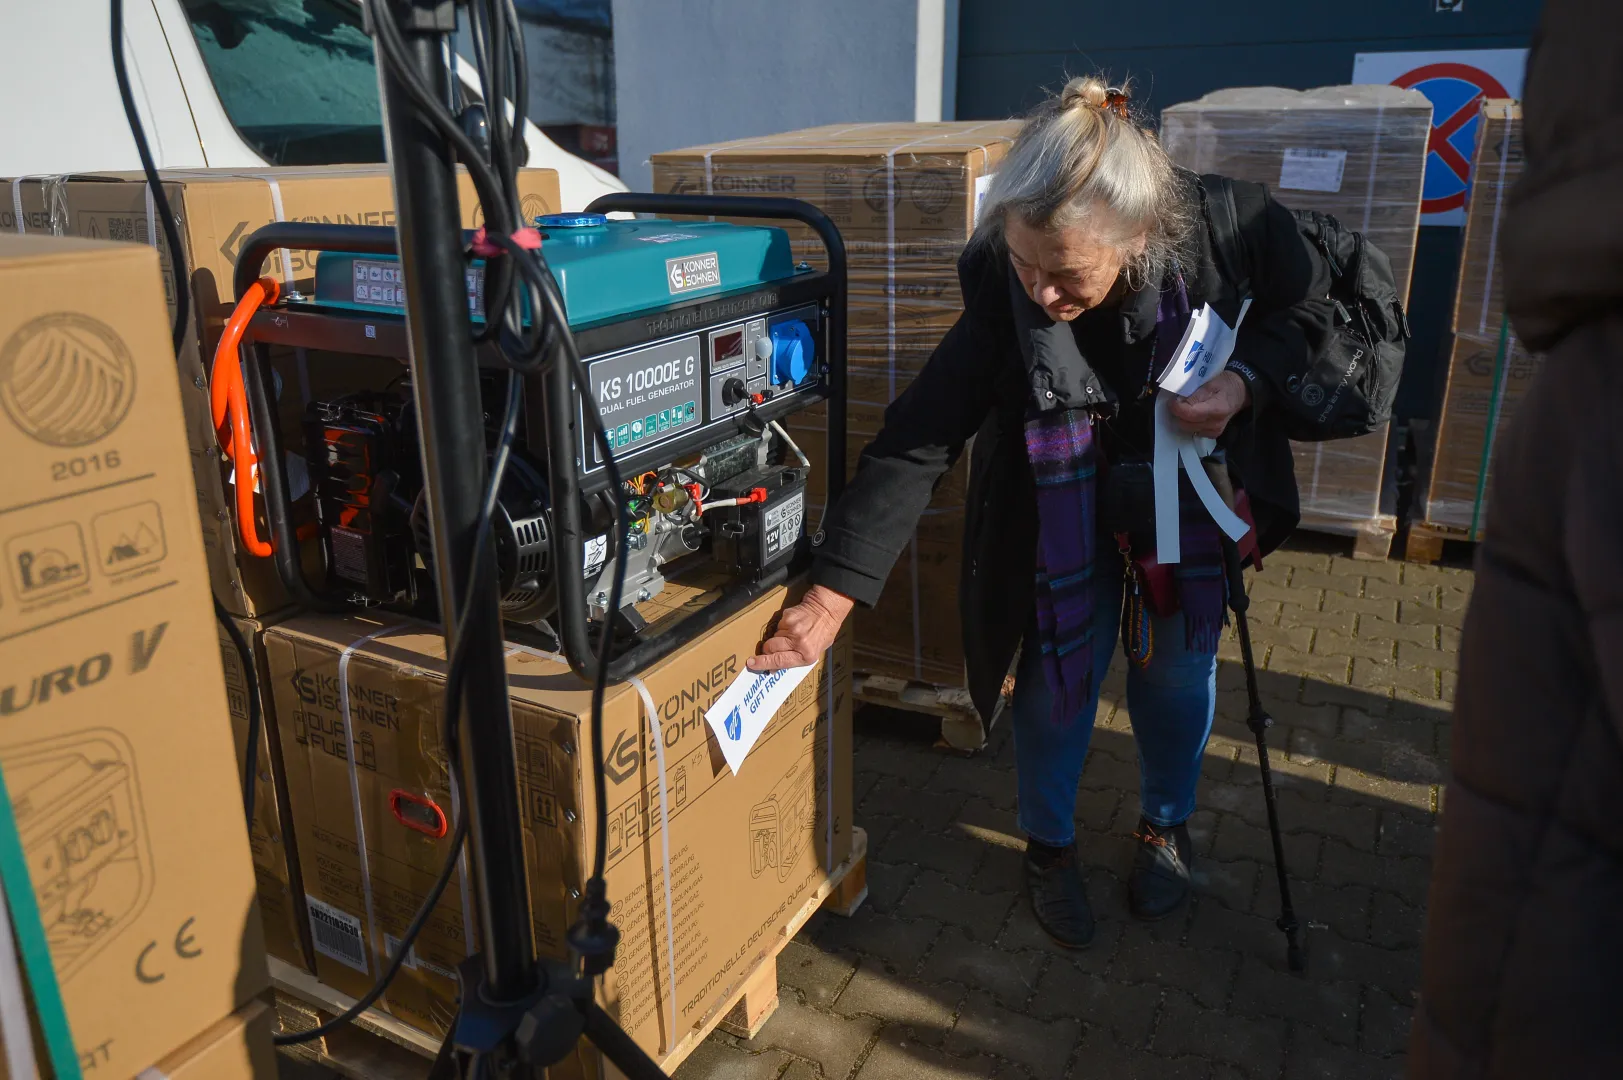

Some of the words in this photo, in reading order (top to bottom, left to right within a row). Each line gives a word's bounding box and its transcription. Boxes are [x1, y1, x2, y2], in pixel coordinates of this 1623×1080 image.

[600, 377, 622, 402] KS
[626, 360, 680, 394] 10000E
[685, 356, 694, 376] G
[1345, 348, 1364, 378] world
[600, 402, 624, 416] DUAL
[626, 396, 646, 408] FUEL
[648, 379, 695, 400] GENERATOR
[51, 449, 122, 482] 2016
[766, 530, 779, 544] 12V
[128, 620, 170, 676] V
[749, 690, 766, 714] GIFT
[681, 944, 747, 1018] TRADITIONELLE
[747, 901, 787, 950] DEUTSCHE
